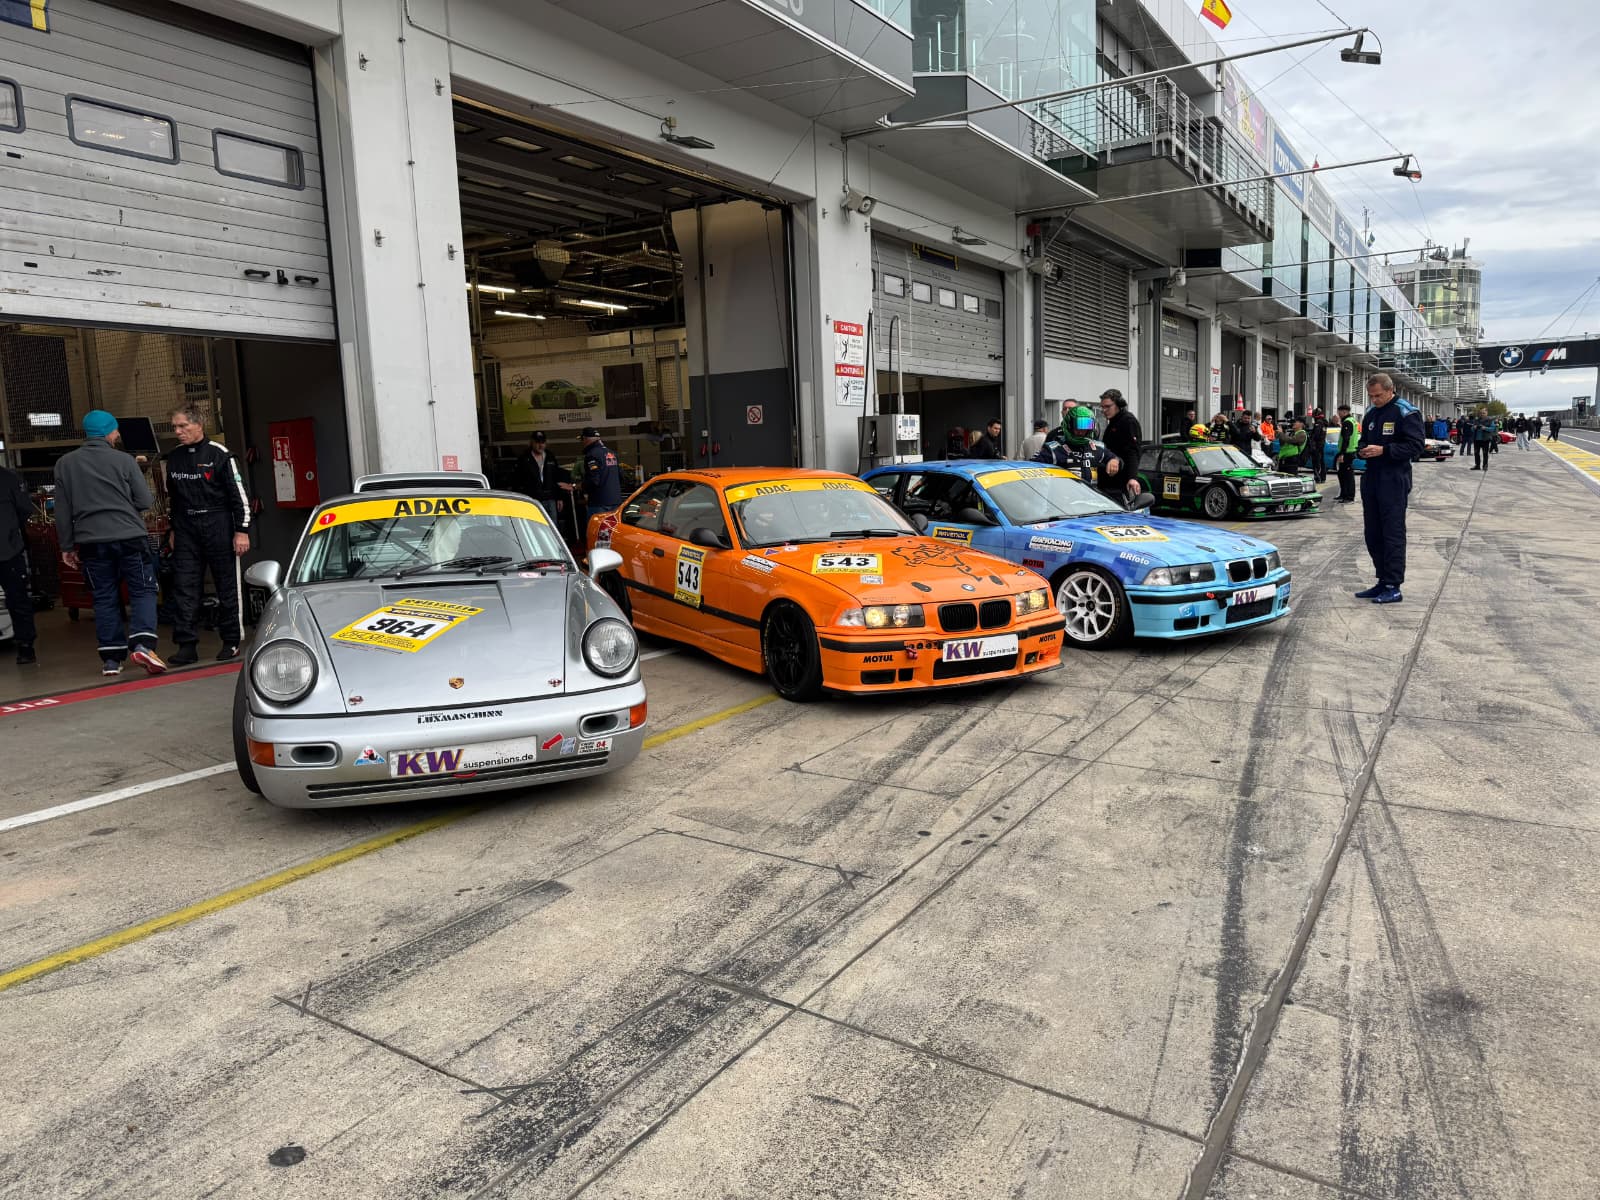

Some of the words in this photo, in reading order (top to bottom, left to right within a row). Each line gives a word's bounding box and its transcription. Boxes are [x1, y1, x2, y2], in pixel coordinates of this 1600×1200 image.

[840, 324, 857, 333] CAUTION
[755, 484, 792, 496] ADAC
[821, 482, 855, 490] ADAC
[1166, 483, 1177, 493] 516
[394, 498, 471, 516] ADAC
[937, 530, 967, 539] RAVENOL
[1108, 526, 1151, 539] 548
[820, 556, 870, 567] 543
[1120, 551, 1150, 565] BRfoto
[678, 562, 699, 590] 543
[1235, 590, 1258, 605] KW
[367, 618, 436, 638] 964
[1039, 634, 1057, 643] MOTUL
[946, 640, 984, 660] KW
[863, 655, 894, 663] MOTUL
[396, 749, 464, 776] KW
[463, 753, 534, 769] suspensions.de
